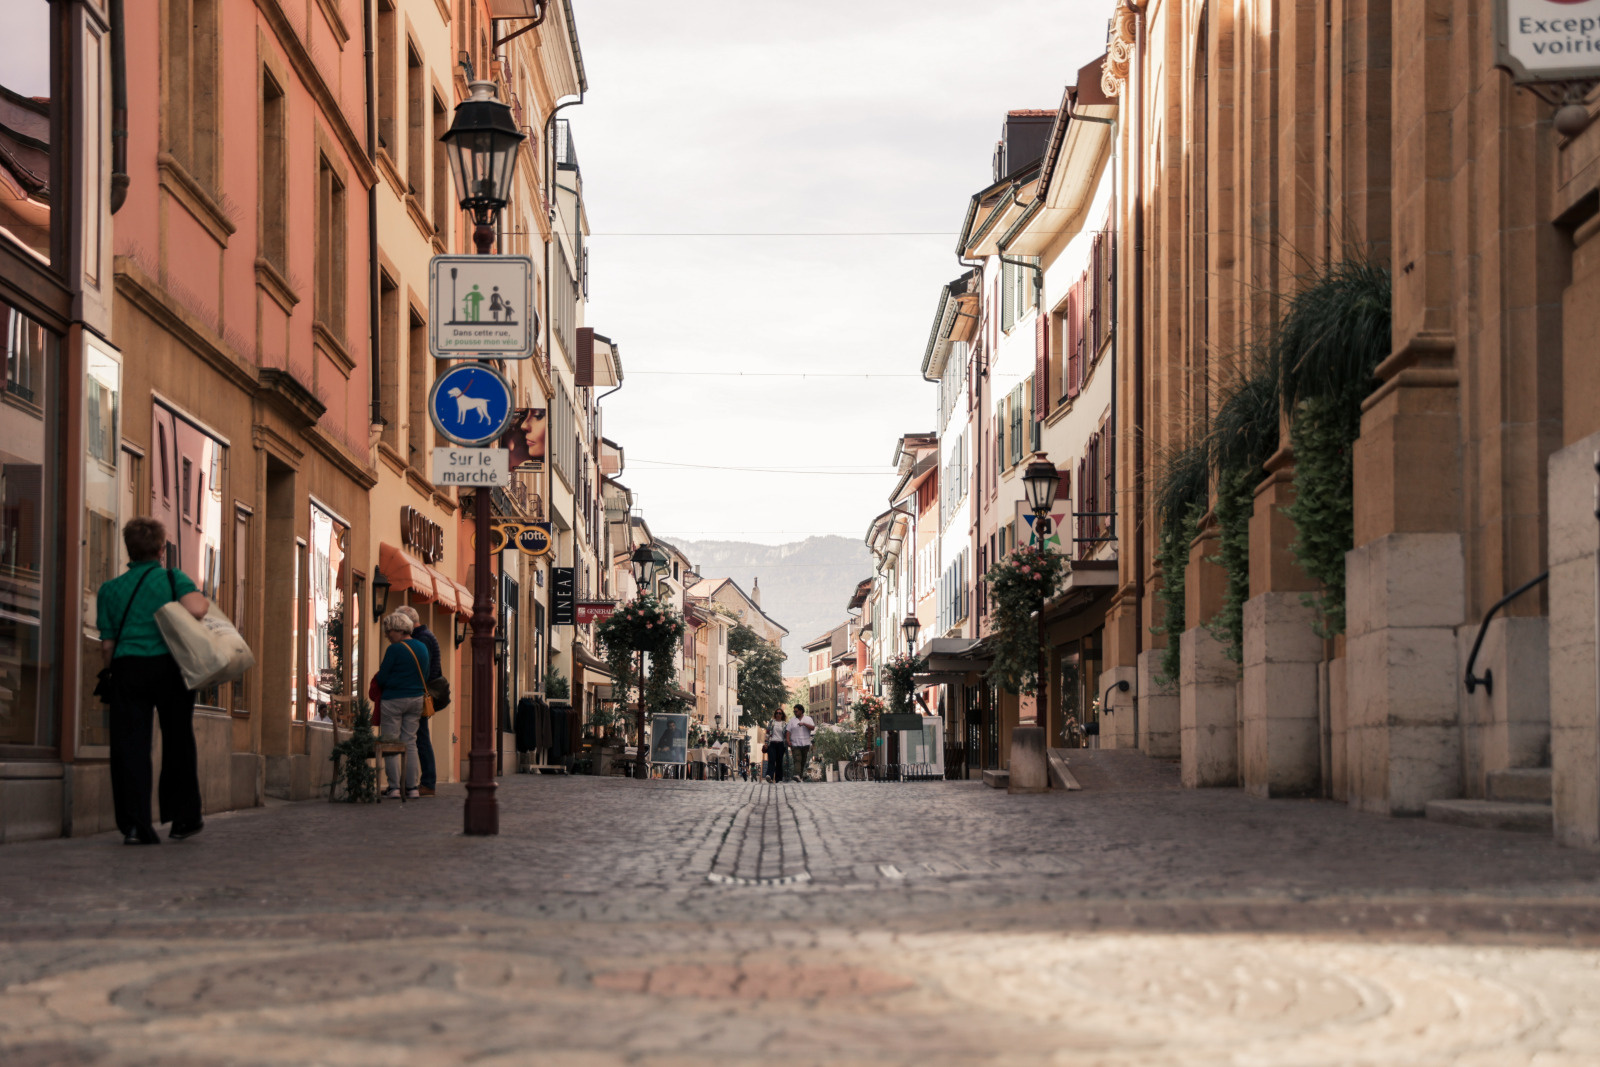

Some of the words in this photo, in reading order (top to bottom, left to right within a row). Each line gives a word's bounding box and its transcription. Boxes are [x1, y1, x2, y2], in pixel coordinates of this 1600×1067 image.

[1519, 17, 1600, 35] Excep
[495, 329, 511, 337] rue,
[449, 451, 473, 465] Sur
[479, 451, 492, 465] le
[443, 469, 497, 482] marché
